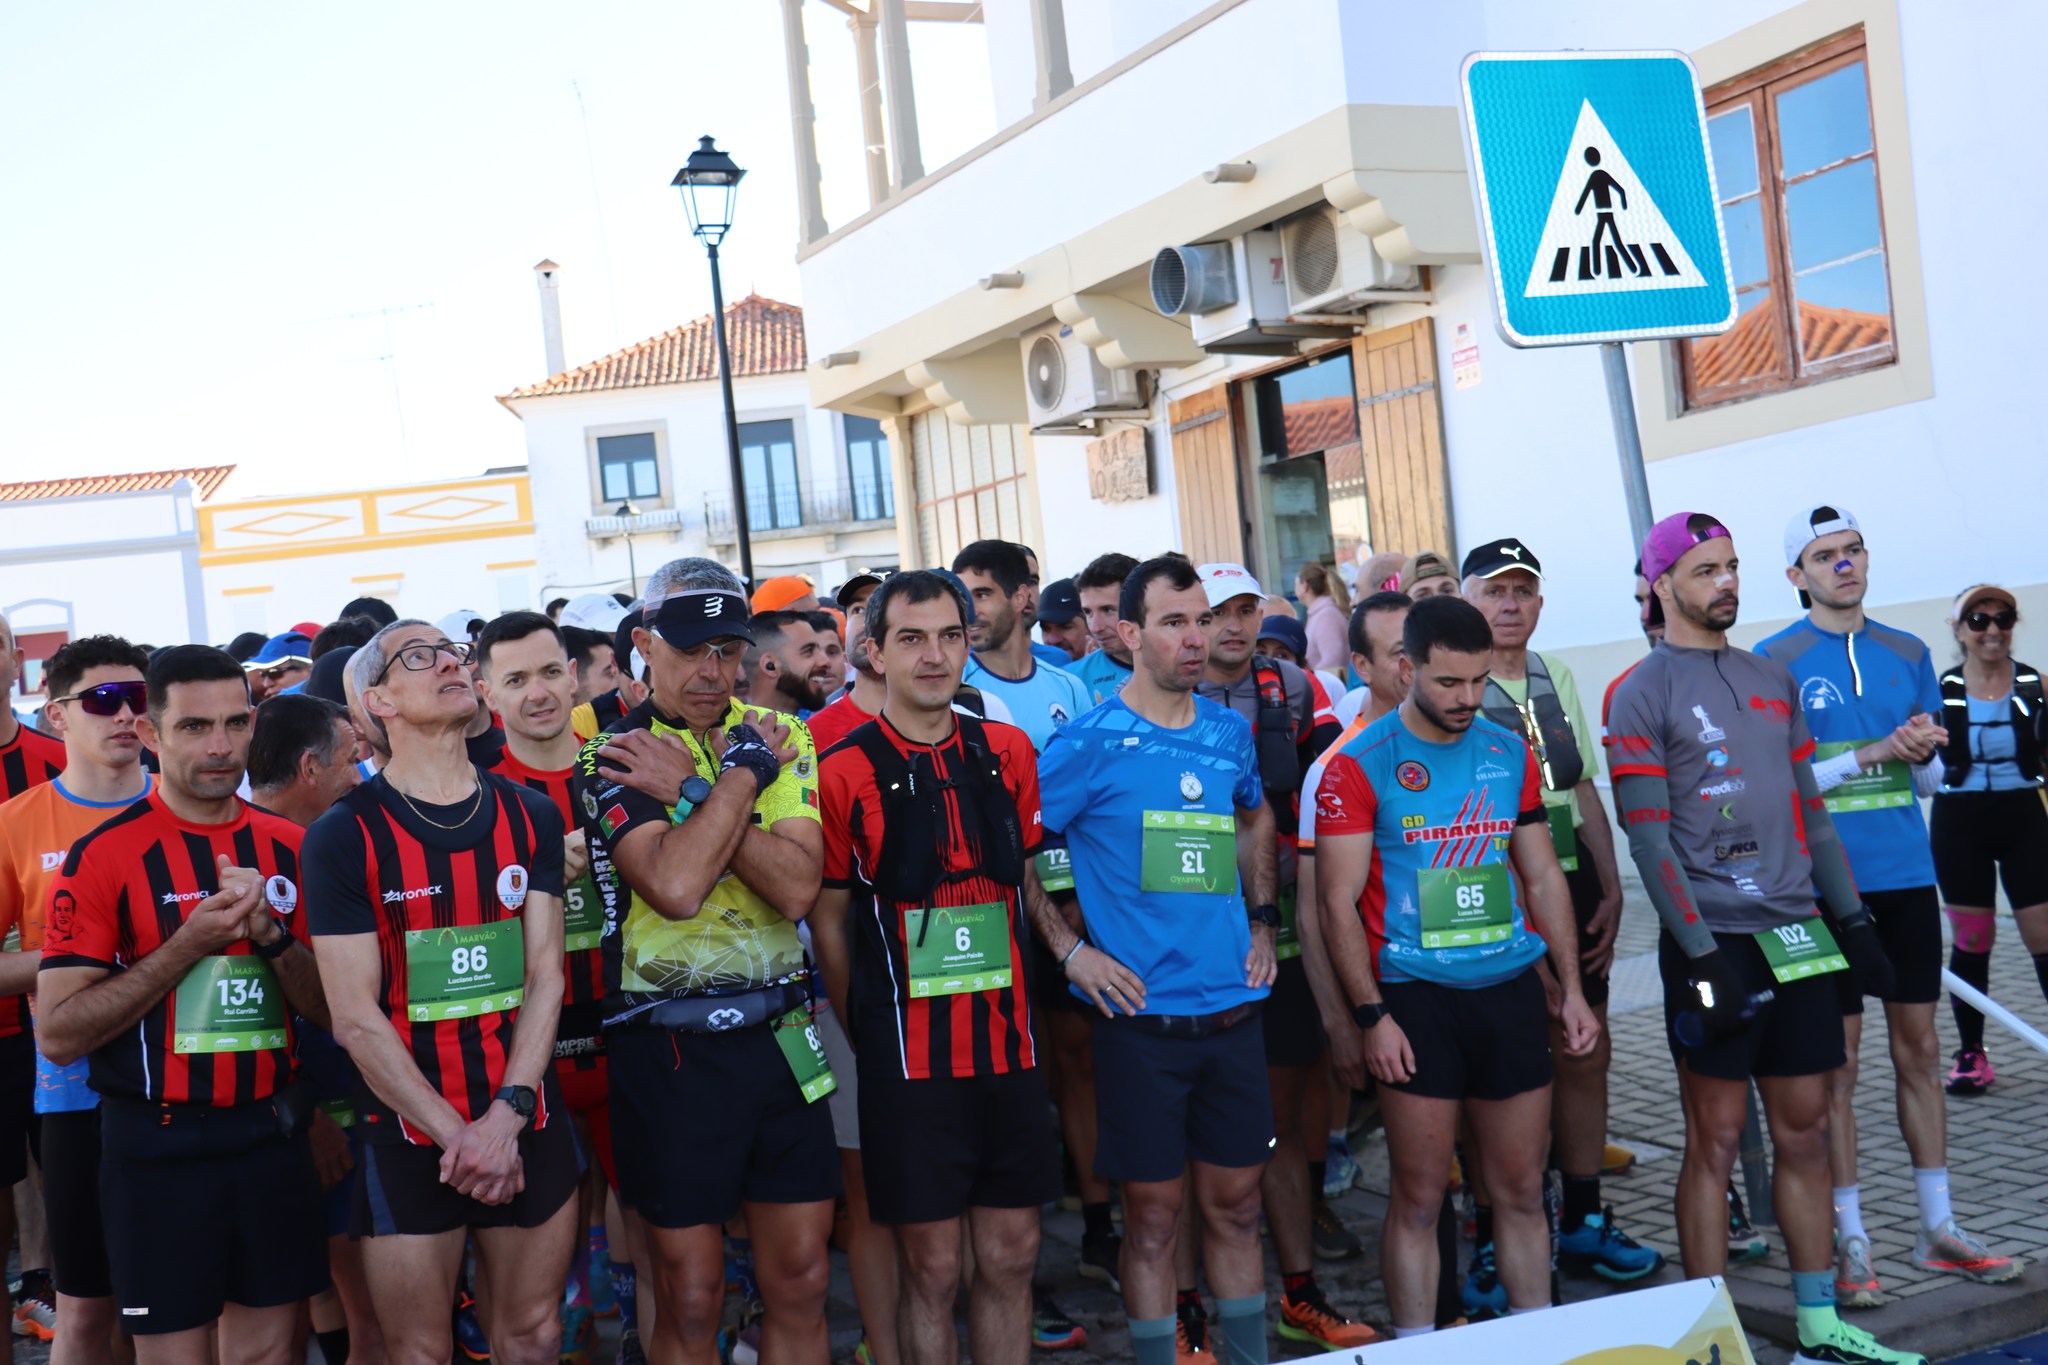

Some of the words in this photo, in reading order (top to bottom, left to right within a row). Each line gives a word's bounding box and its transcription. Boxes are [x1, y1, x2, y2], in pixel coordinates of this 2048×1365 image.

[1401, 815, 1426, 828] GD
[1181, 850, 1206, 874] 13
[563, 887, 585, 912] 5
[1456, 884, 1485, 908] 65
[954, 913, 985, 925] MARVÃO
[460, 930, 497, 944] MARVÃO
[955, 926, 971, 952] 6
[1773, 923, 1812, 946] 102
[451, 945, 488, 974] 86
[447, 975, 473, 985] Luciano
[216, 978, 264, 1006] 134
[224, 1008, 235, 1016] Rui
